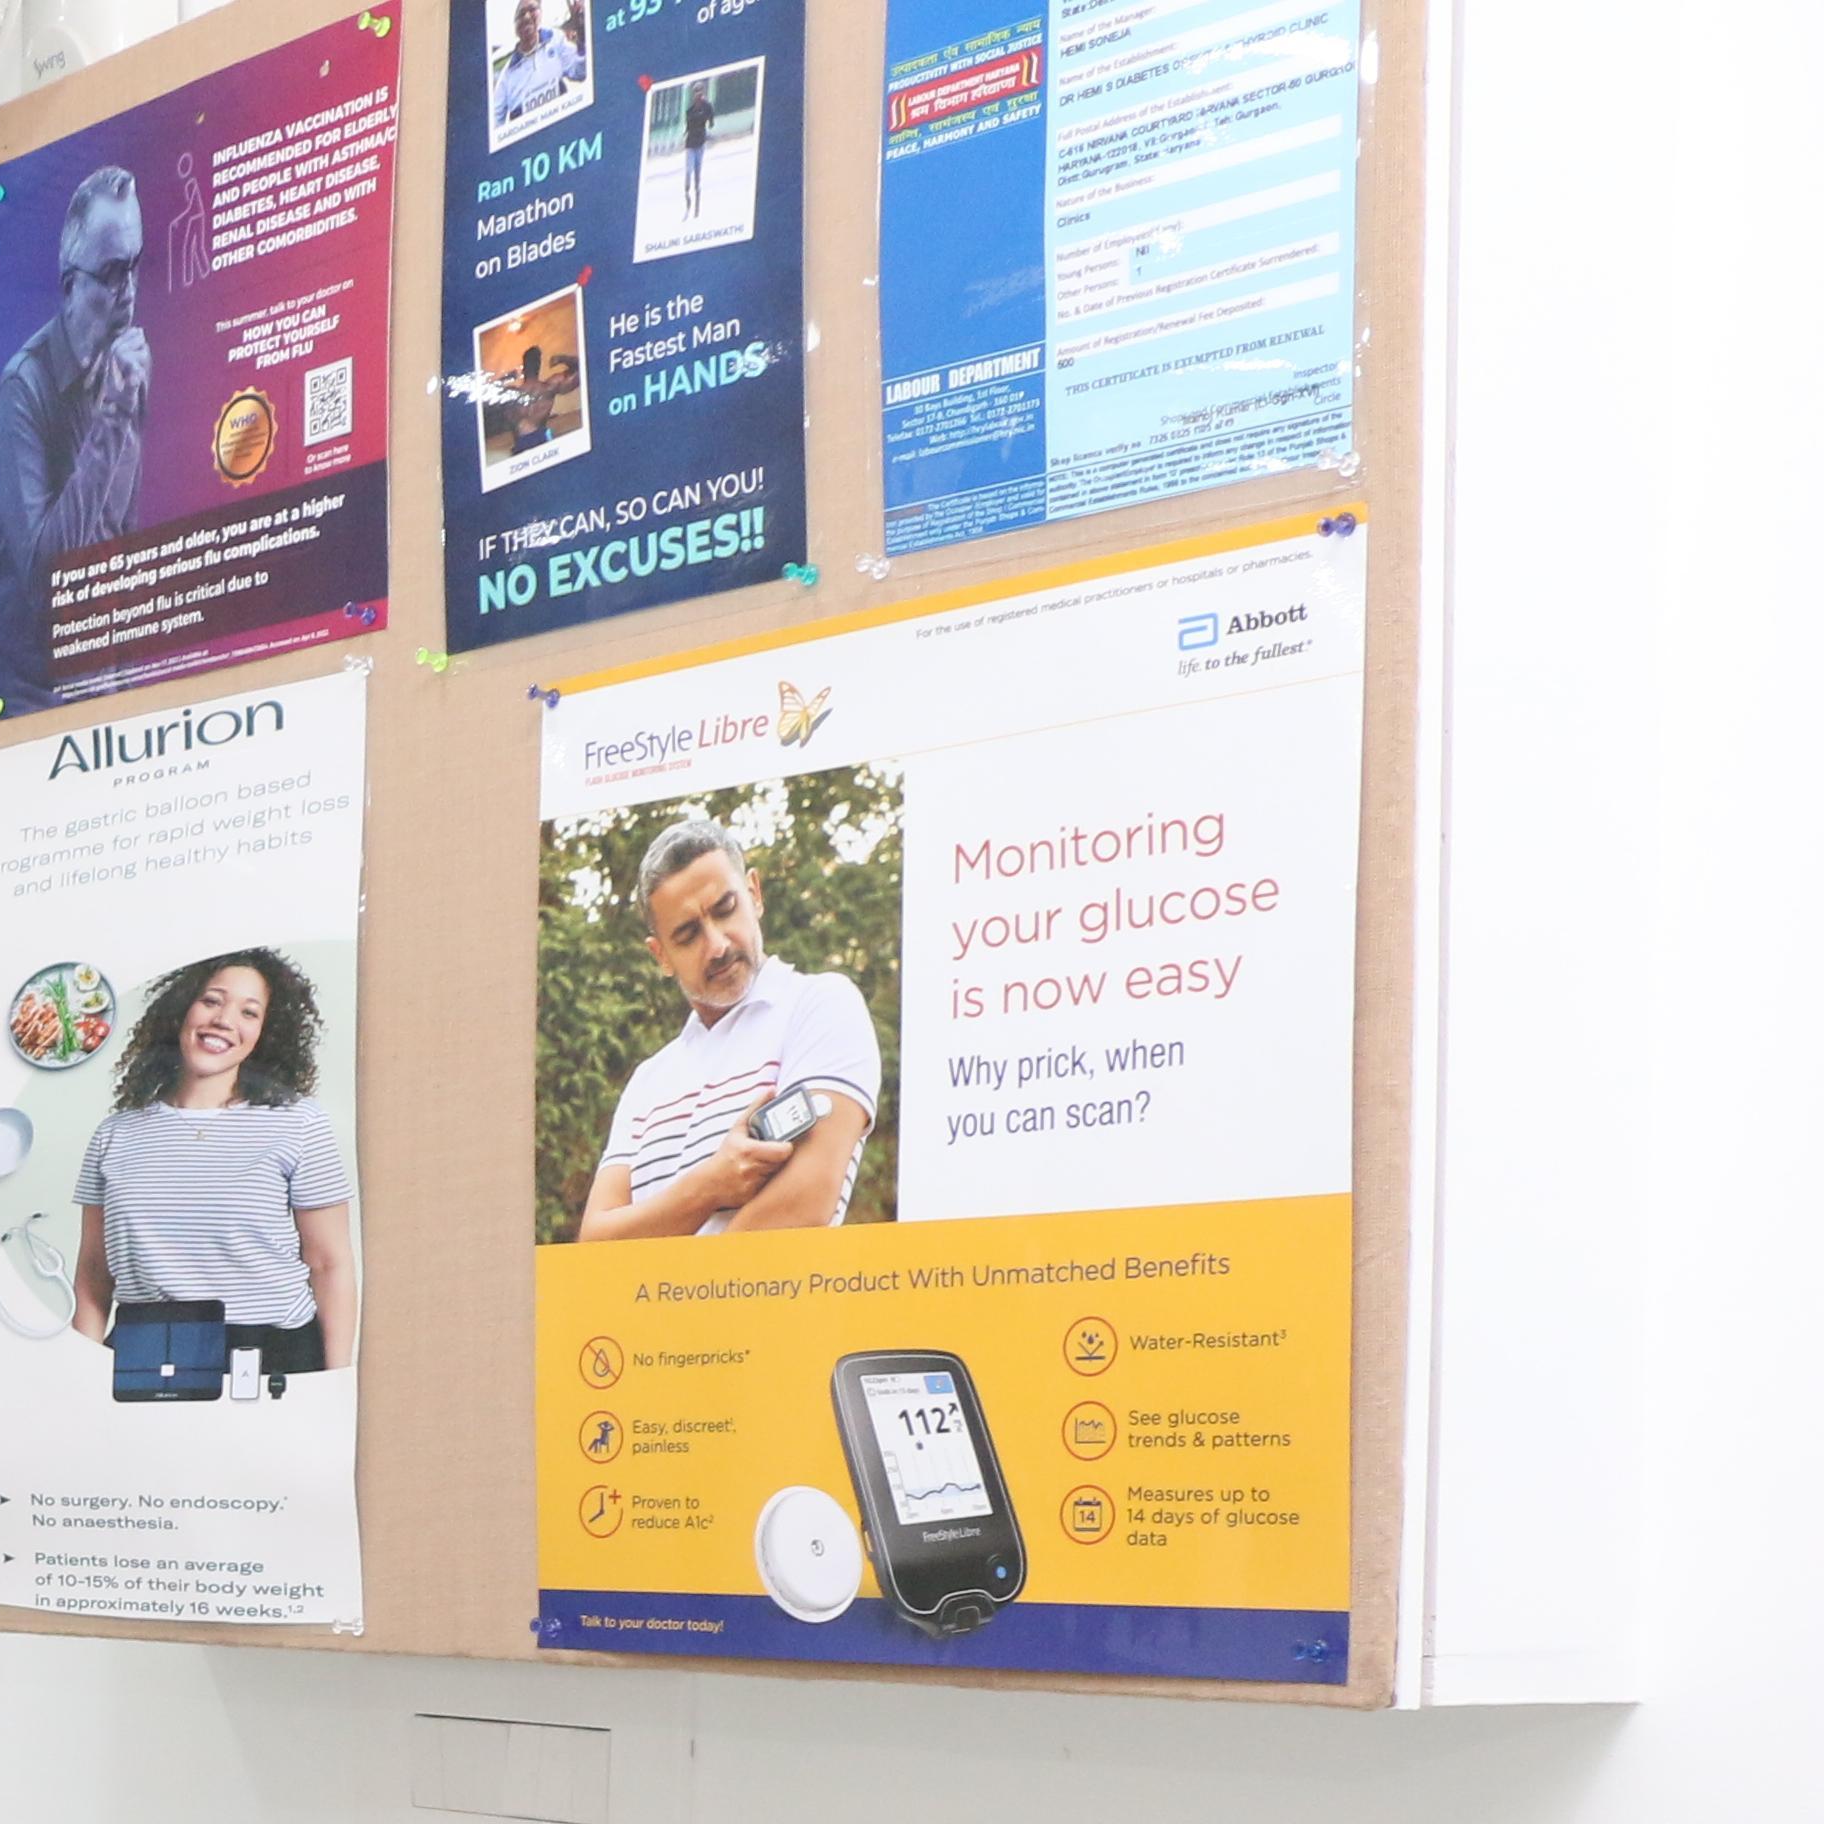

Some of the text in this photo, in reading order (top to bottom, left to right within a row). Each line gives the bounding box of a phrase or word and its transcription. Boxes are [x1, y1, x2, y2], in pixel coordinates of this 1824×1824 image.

[212, 85, 388, 166] INFLUENZA VACCINATION IS
[212, 100, 398, 187] RECOMMENDED FOR ELDERLY
[885, 102, 1042, 160] PEACE, HARMONY AND SAFETY
[212, 186, 240, 208] AND
[242, 166, 291, 197] PEOPLE
[294, 152, 329, 178] WITH
[212, 154, 380, 229] DIABETES, HEART DISEASE,
[477, 131, 602, 203] Ran 10 KM
[211, 206, 357, 270] OTHER COMORBIDITIES.
[212, 176, 376, 250] RENAL DISEASE AND WITH
[476, 191, 574, 240] Marathon
[474, 230, 576, 278] on Blades
[644, 237, 680, 253] SHALINI
[228, 314, 339, 362] PROTECT YOURSELF
[242, 303, 326, 342] HOW YOU CAN
[609, 293, 704, 338] He is the
[256, 339, 313, 369] FROM FLU
[609, 318, 740, 373] Fastest Man
[1064, 324, 1324, 396] THIS CERTIFICATE IS EXEMPTED FROM RENEWAL
[608, 340, 769, 415] on HANDS
[885, 346, 1041, 405] LABOUR DEPARTMENT
[509, 447, 559, 475] ZION CLARK
[478, 466, 763, 560] IF THEY CAN, SO CAN YOU!
[51, 525, 320, 607] risk of developing serious flu complications.
[478, 505, 765, 614] NO EXCUSES!!
[1226, 603, 1307, 635] Abbott
[48, 699, 285, 780] Allurion
[584, 714, 769, 770] FreeStyle Libre
[112, 758, 209, 788] PROGRAM
[19, 769, 311, 842] The gastric balloon based
[111, 833, 141, 851] for
[147, 818, 204, 844] rapid
[211, 803, 291, 832] weight
[301, 794, 350, 816] loss
[12, 830, 312, 897] and lifelong healthy habits
[954, 811, 1224, 884] Monitoring
[951, 877, 1279, 961] your glucose
[952, 954, 1242, 1019] is now easy
[947, 1038, 1184, 1091] Why prick, when
[946, 1089, 1151, 1145] you can scan?
[634, 1251, 1230, 1302] A Revolutionary Product With Unmatched Benefits
[632, 1352, 654, 1366] No
[632, 1418, 668, 1436] Easy,
[1127, 1408, 1240, 1428] See glucose
[1127, 1430, 1291, 1450] trends & patterns
[631, 1438, 689, 1456] painless
[30, 1492, 55, 1506] No
[60, 1495, 132, 1511] surgery.
[137, 1494, 164, 1508] No
[631, 1494, 700, 1510] Proven to
[1126, 1507, 1300, 1528] 14 days of glucose
[1127, 1485, 1270, 1504] Measures up to
[31, 1513, 178, 1530] No anaesthesia.
[630, 1514, 680, 1529] reduce
[1125, 1529, 1167, 1547] data
[34, 1551, 264, 1576] Patients lose an average
[34, 1572, 52, 1586] of
[123, 1576, 143, 1590] of
[146, 1577, 190, 1592] their
[194, 1579, 247, 1598] body
[251, 1582, 324, 1600] weight
[35, 1594, 51, 1606] in
[56, 1595, 185, 1615] approximately
[190, 1602, 210, 1615] 16
